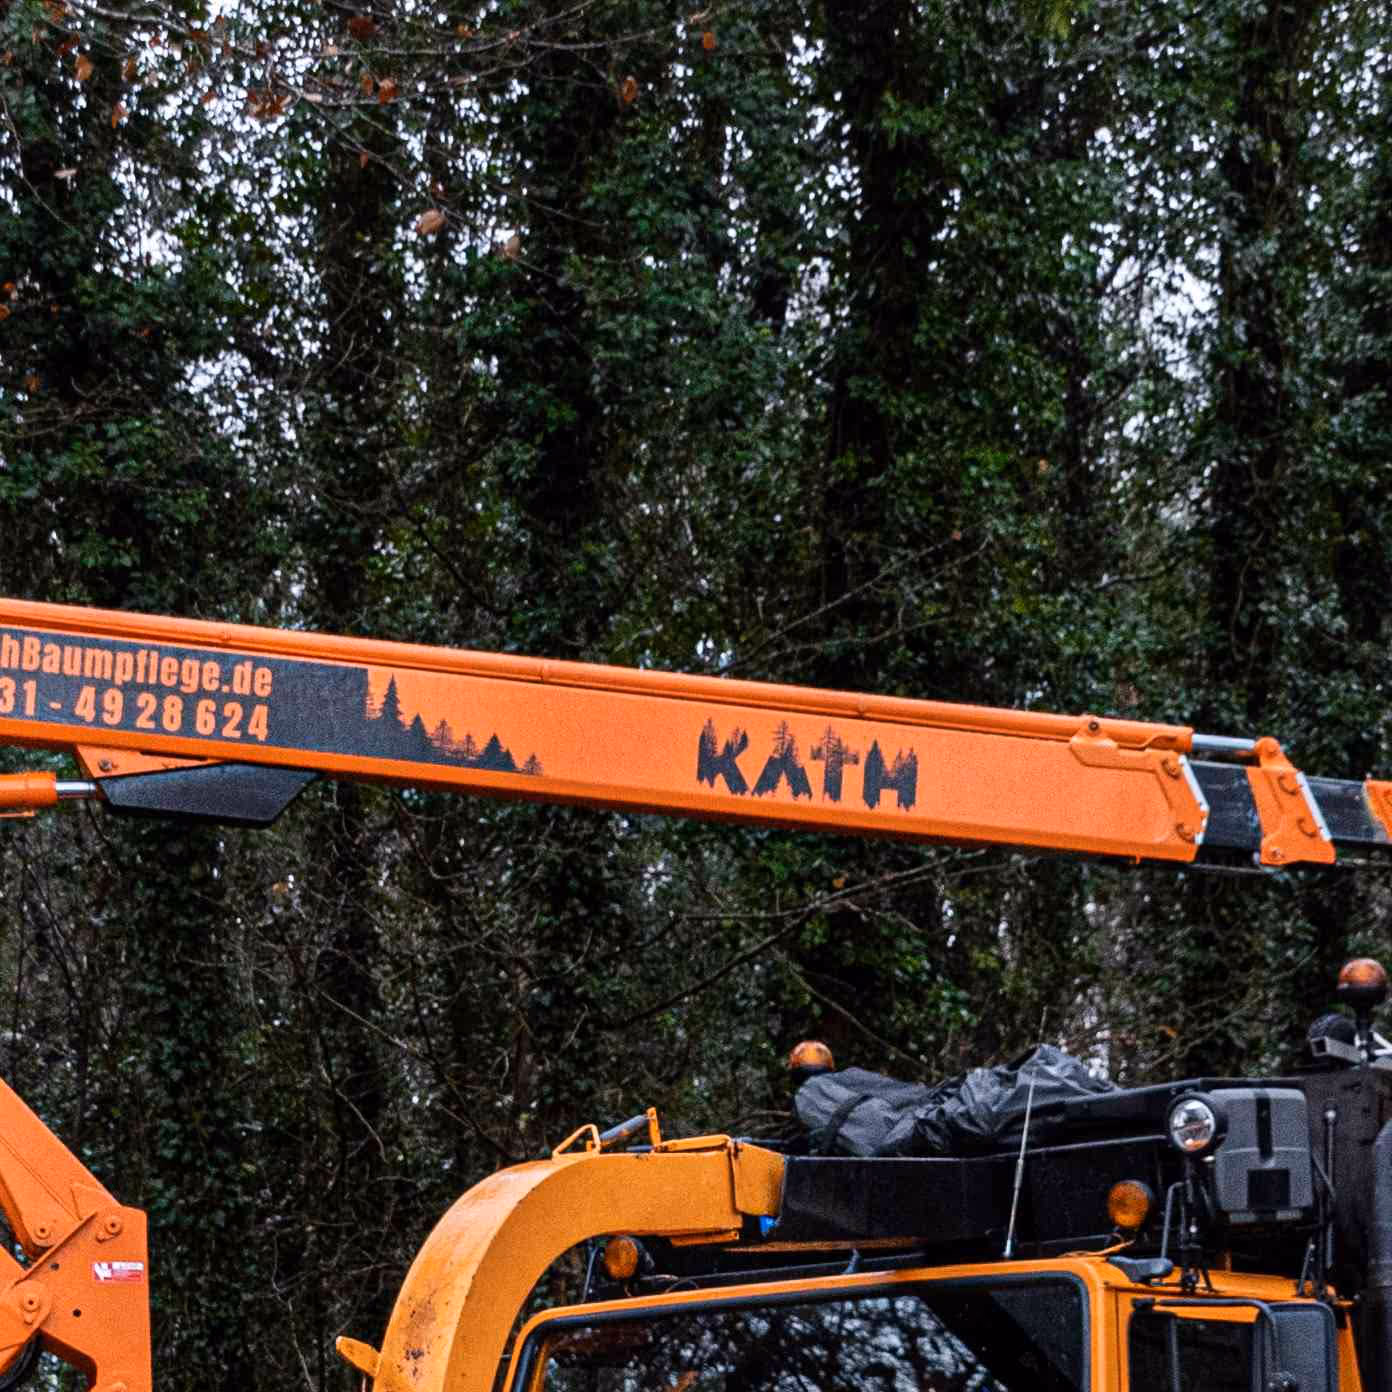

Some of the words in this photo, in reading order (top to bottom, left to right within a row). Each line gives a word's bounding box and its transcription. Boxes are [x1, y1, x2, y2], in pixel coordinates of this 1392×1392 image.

[74, 685, 124, 725] 49
[135, 692, 183, 732] 28
[196, 699, 269, 741] 624
[697, 718, 919, 812] KATH
